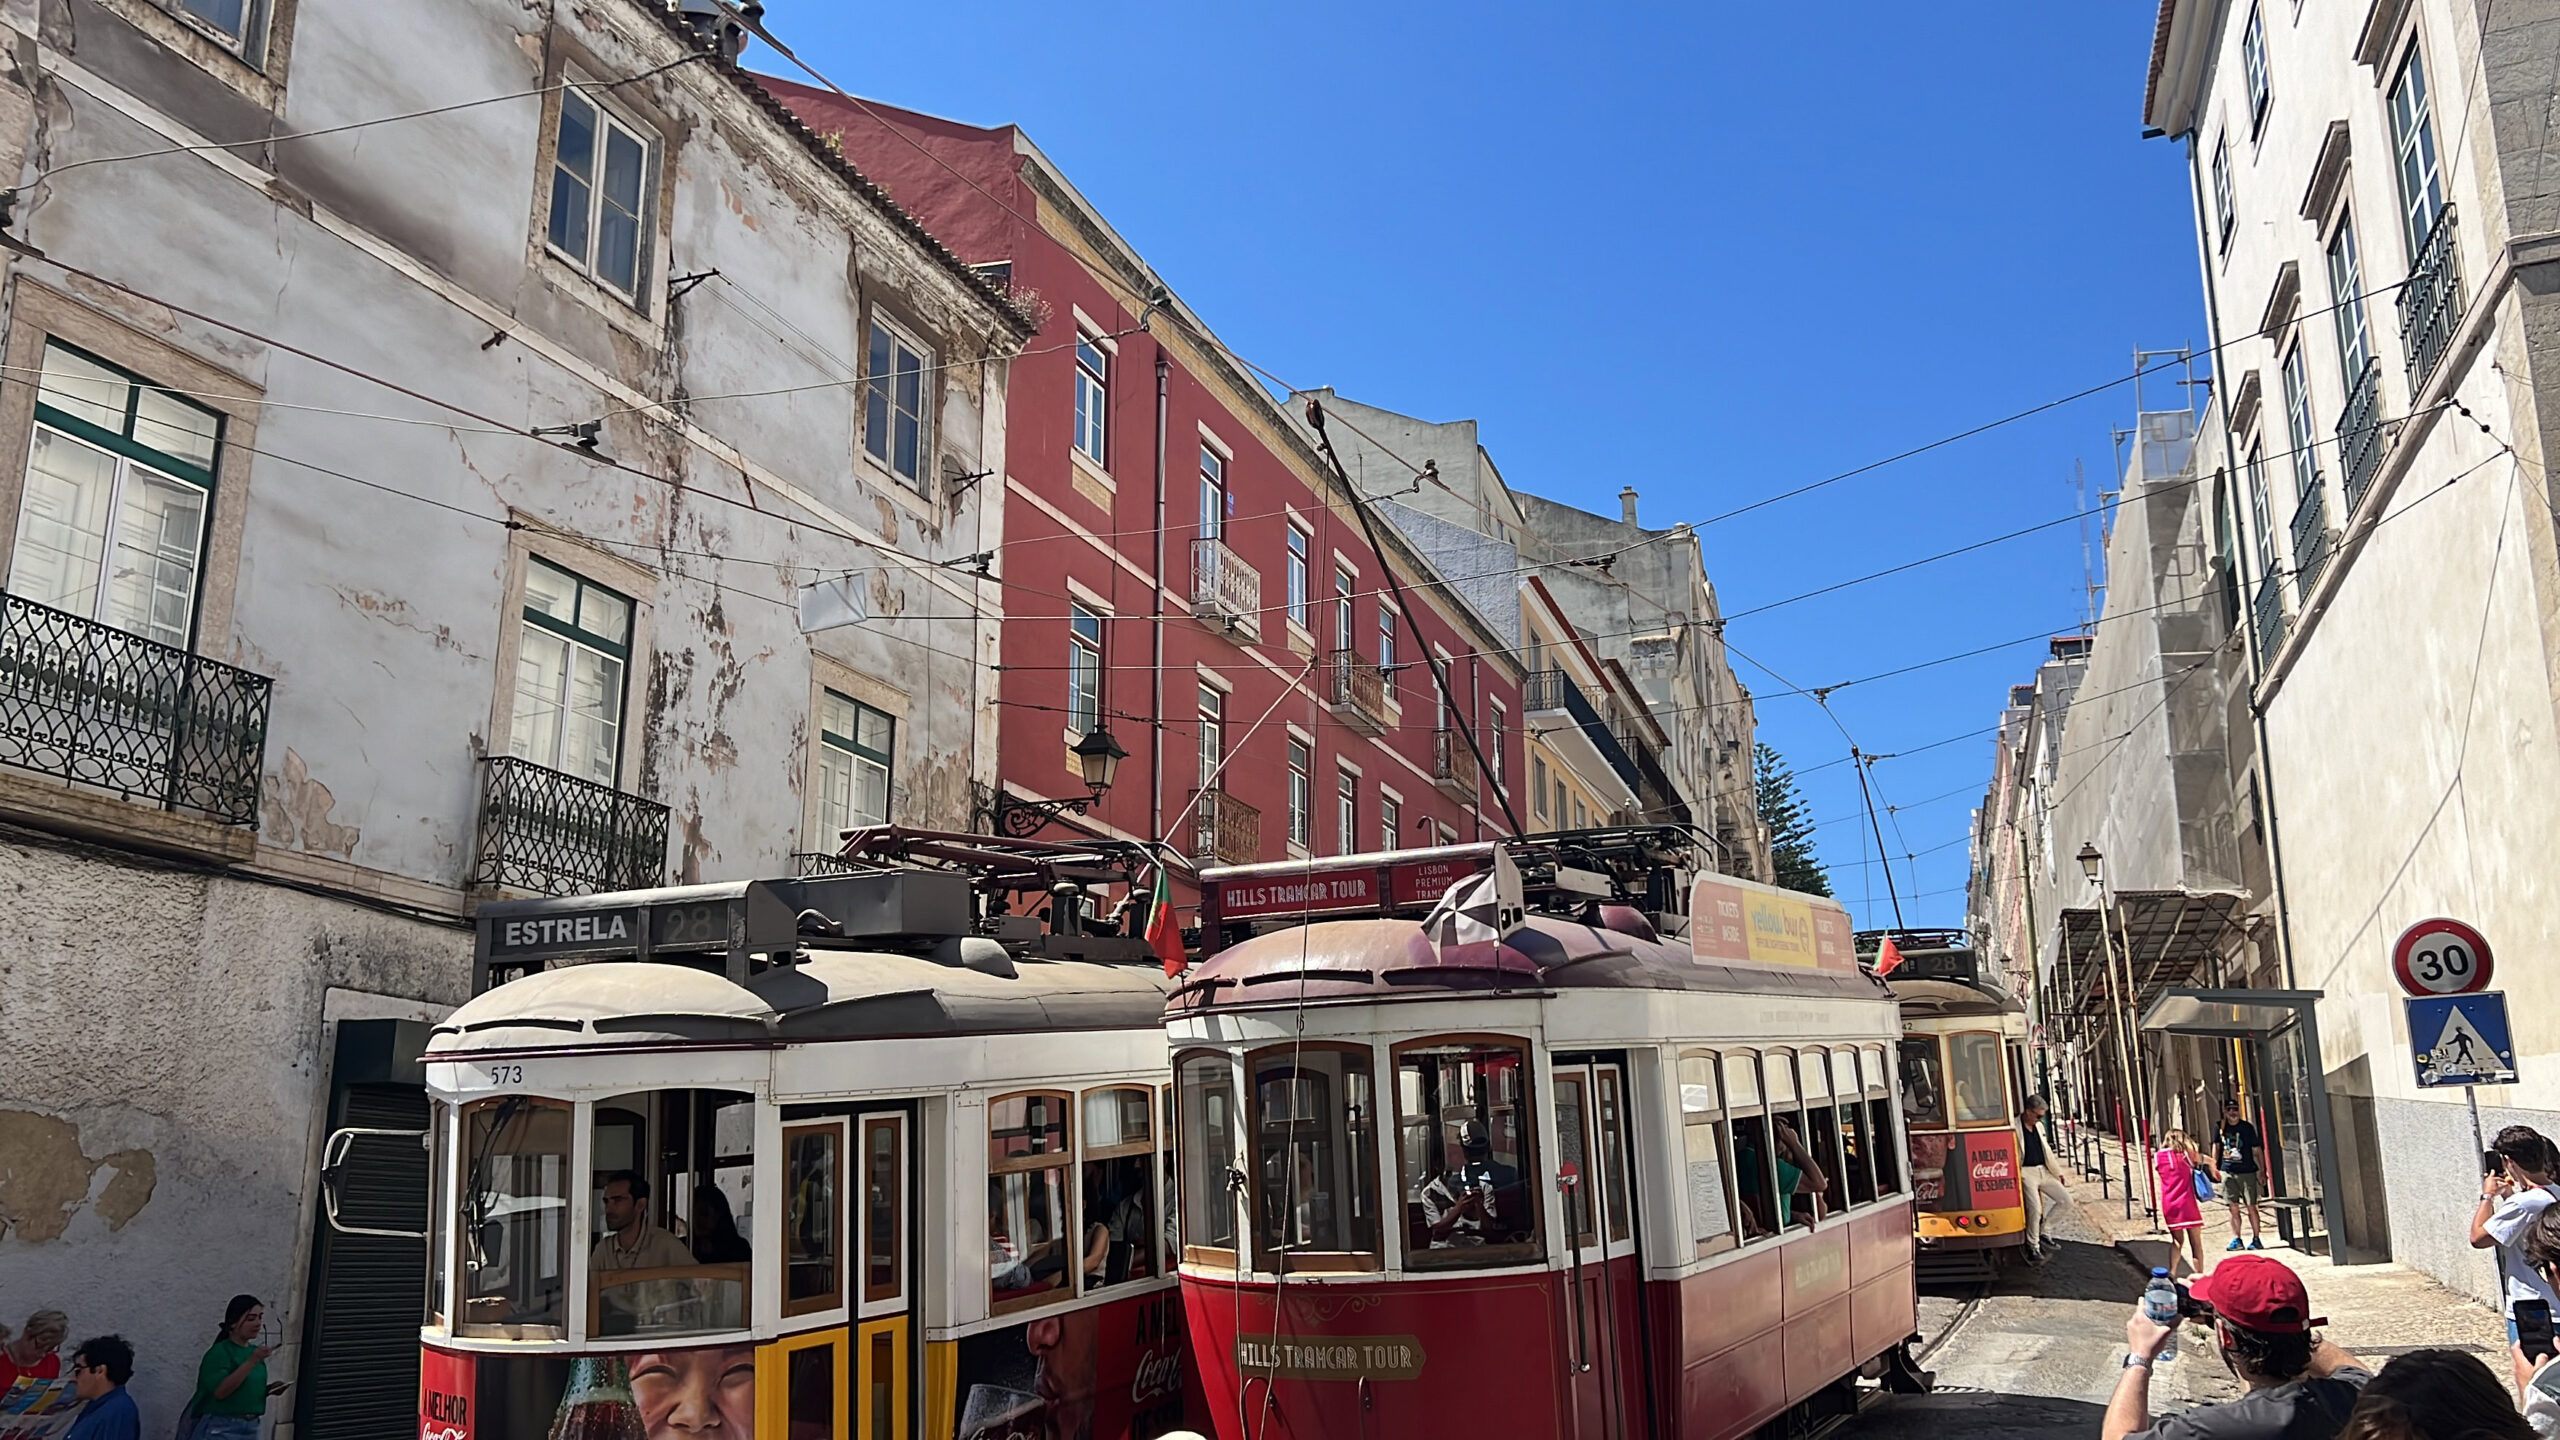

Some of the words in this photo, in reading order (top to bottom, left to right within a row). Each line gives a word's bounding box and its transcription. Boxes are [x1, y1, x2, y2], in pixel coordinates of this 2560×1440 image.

[1415, 876, 1453, 888] PREMIUM
[1418, 864, 1449, 876] LISBON
[1226, 887, 1267, 907] HILLS
[1269, 883, 1328, 904] TRAMCAR
[1330, 879, 1367, 899] TOUR
[1416, 889, 1445, 900] TRAMC
[505, 915, 628, 946] ESTRELA
[663, 905, 713, 943] 28
[1930, 955, 1957, 972] 28
[2416, 944, 2469, 981] 30
[491, 1065, 523, 1085] 573
[1151, 1297, 1181, 1341] MEL
[1240, 1342, 1281, 1368] HILLS
[1284, 1344, 1359, 1369] TRAMCAR
[1362, 1344, 1413, 1369] TOUR
